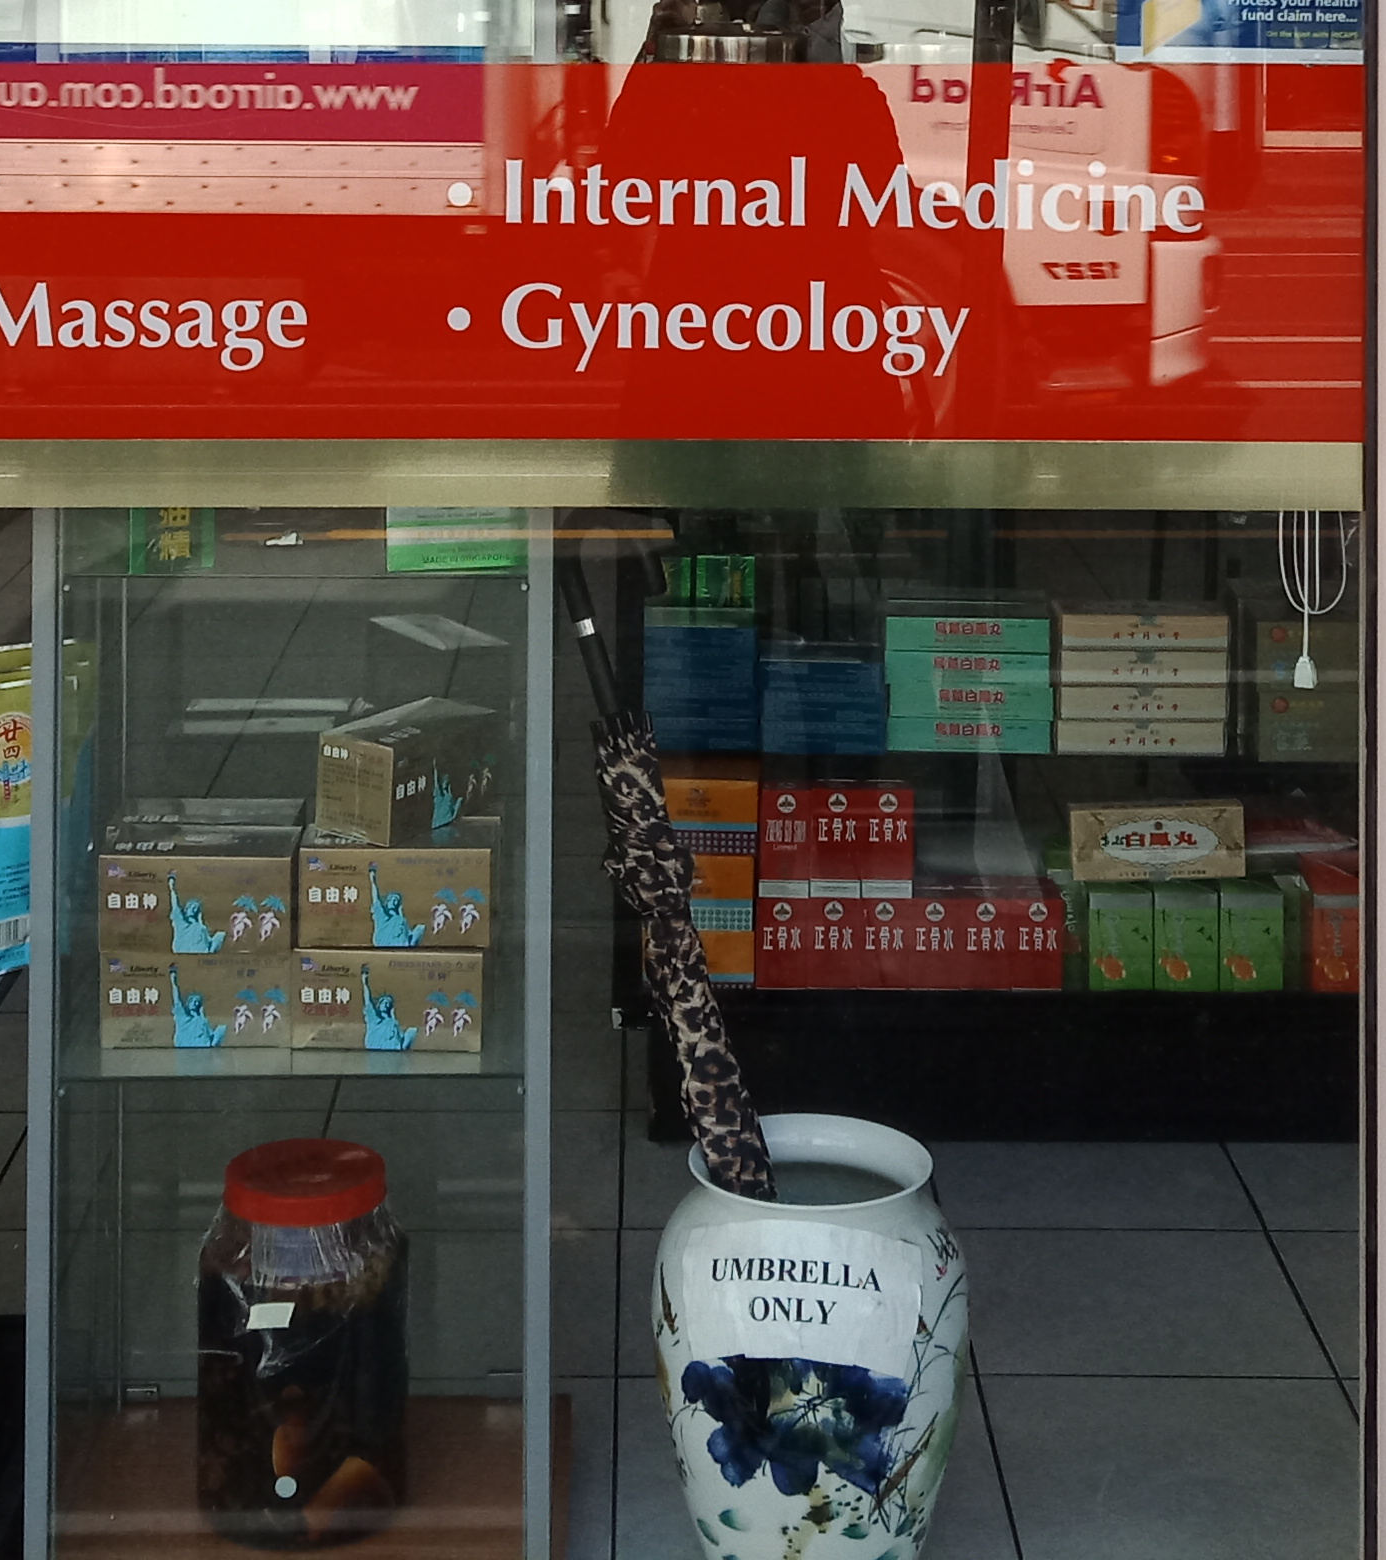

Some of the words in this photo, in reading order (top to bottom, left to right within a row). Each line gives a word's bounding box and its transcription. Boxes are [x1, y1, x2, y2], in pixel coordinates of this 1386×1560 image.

[1241, 9, 1275, 23] fund
[1277, 10, 1313, 23] claim
[502, 156, 808, 230] Internal
[838, 156, 1205, 236] Medicine
[500, 281, 971, 378] Gynecology
[816, 816, 857, 844] 正骨水
[867, 816, 908, 844] 正骨水
[106, 891, 159, 910] 自由神
[307, 886, 358, 904] 自由神
[762, 926, 802, 952] 正骨水
[813, 926, 854, 952] 正骨水
[864, 926, 905, 952] 正骨水
[915, 926, 955, 952] 正骨水
[966, 926, 1006, 952] 正骨水
[1018, 926, 1059, 952] 正骨水
[108, 988, 159, 1005] 自由神
[300, 988, 351, 1005] 自由神
[710, 1256, 883, 1293] UMBRELLA
[748, 1294, 838, 1327] ONLY
